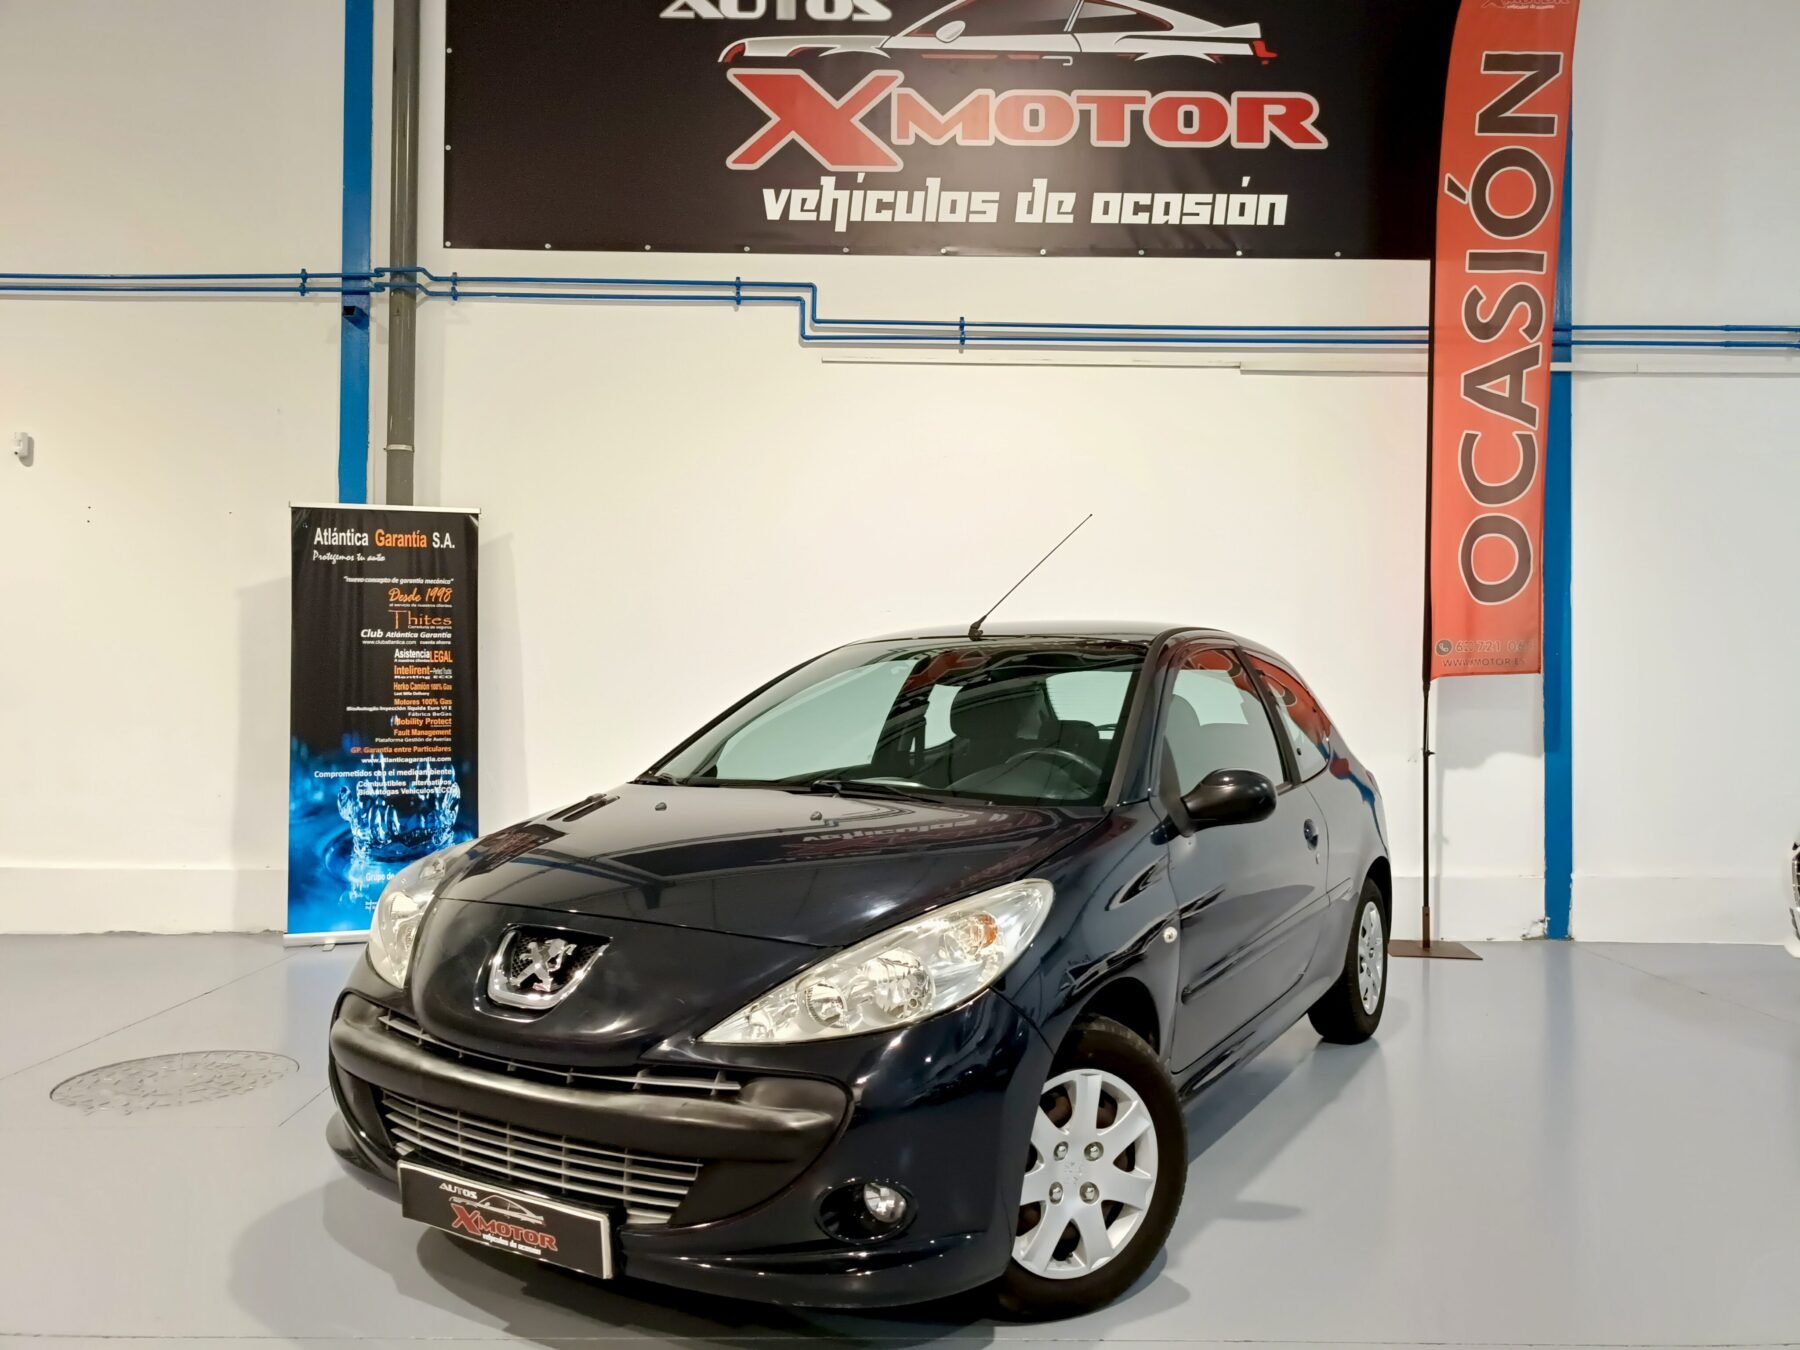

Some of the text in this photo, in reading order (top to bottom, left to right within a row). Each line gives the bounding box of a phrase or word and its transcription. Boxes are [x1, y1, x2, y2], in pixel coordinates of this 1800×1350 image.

[725, 67, 1328, 172] XMOTOR
[762, 172, 1288, 232] vehículos de ocasión
[1444, 51, 1564, 605] OCASIÓN
[313, 527, 455, 548] Atlántica Garantía S.A.
[312, 550, 354, 565] Protegemos
[356, 553, 366, 562] tu
[388, 587, 453, 603] Desde 1998
[388, 610, 452, 630] Thites
[360, 629, 452, 639] Club Atlántica Garantía
[425, 717, 452, 726] Protect
[411, 729, 452, 737] Management
[413, 745, 452, 753] Particulares
[314, 770, 372, 779] Comprometidos
[439, 1182, 478, 1200] AUTOS
[450, 1202, 559, 1252] XMOTOR
